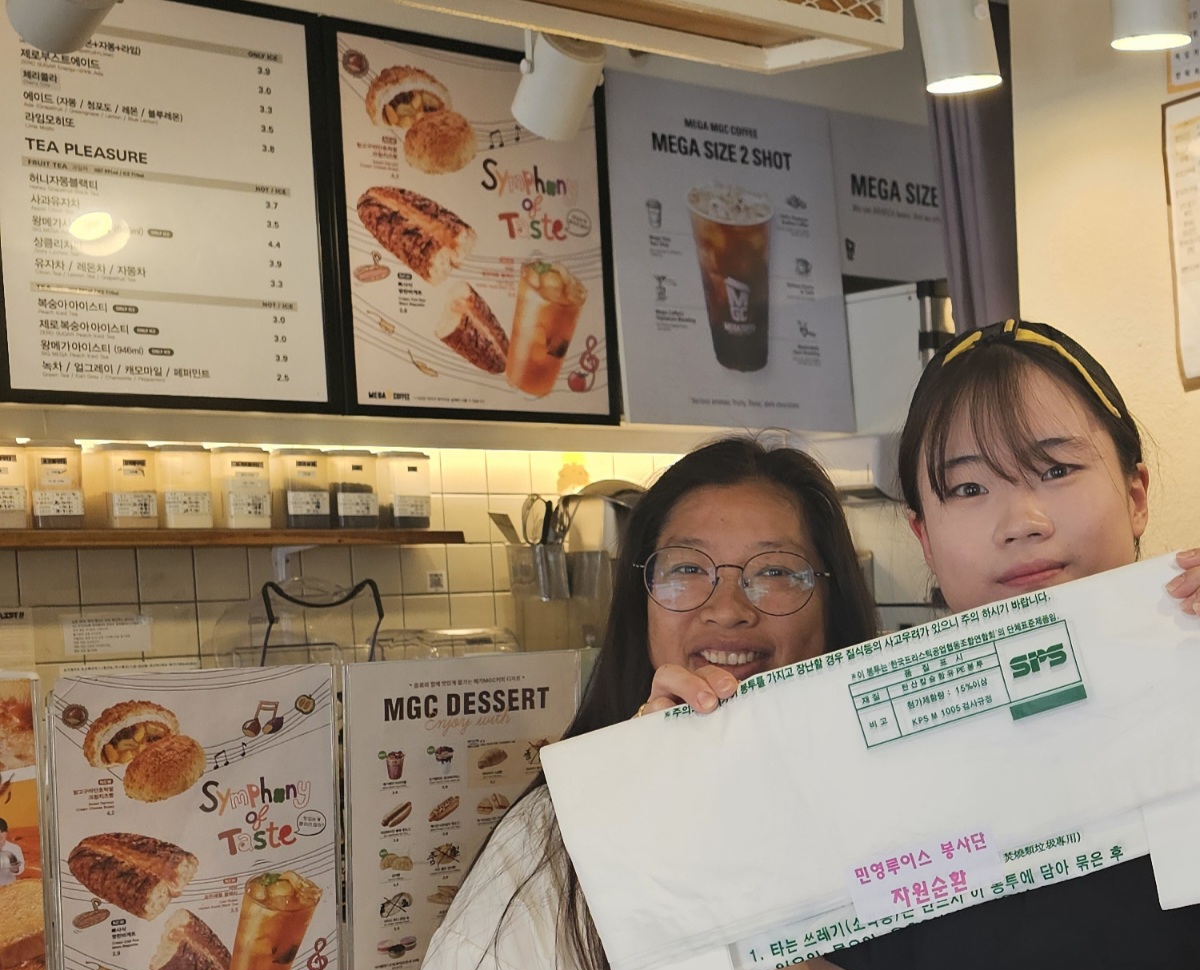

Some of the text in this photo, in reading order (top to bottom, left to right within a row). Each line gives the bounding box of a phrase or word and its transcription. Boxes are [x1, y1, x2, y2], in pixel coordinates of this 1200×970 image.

[23, 91, 54, 105] 에이드
[25, 137, 148, 165] TEA PLEASURE
[651, 131, 792, 172] MEGA SIZE 2 SHOT
[481, 158, 578, 205] Symphony
[851, 173, 939, 208] MEGA SIZE
[522, 195, 543, 218] of
[498, 212, 567, 241] Taste
[268, 240, 281, 249] 4.4
[767, 668, 795, 683] 가지고
[796, 658, 823, 675] 장난할
[826, 652, 844, 667] 경우
[846, 640, 882, 660] 질식등의
[884, 625, 930, 648] 사고우려가
[931, 616, 960, 635] 있으니
[961, 610, 980, 625] 주의
[982, 602, 1010, 619] 하시기
[1010, 591, 1051, 611] 바랍니다.
[955, 677, 988, 695] 15%이상
[384, 687, 550, 722] MGC DESSERT
[912, 695, 993, 727] KPS M 1005 검사규정
[425, 708, 512, 737] Enjoy with
[199, 777, 311, 816] Symphony
[245, 804, 269, 831] of
[218, 821, 297, 856] Taste
[854, 832, 988, 885] 민영루이스 봉사단
[750, 949, 764, 963] 1.
[769, 938, 798, 957] 타는
[1040, 860, 1069, 881] 담아
[1076, 851, 1103, 872] 묶은
[1110, 845, 1123, 862] 후
[890, 869, 968, 908] 자원순환
